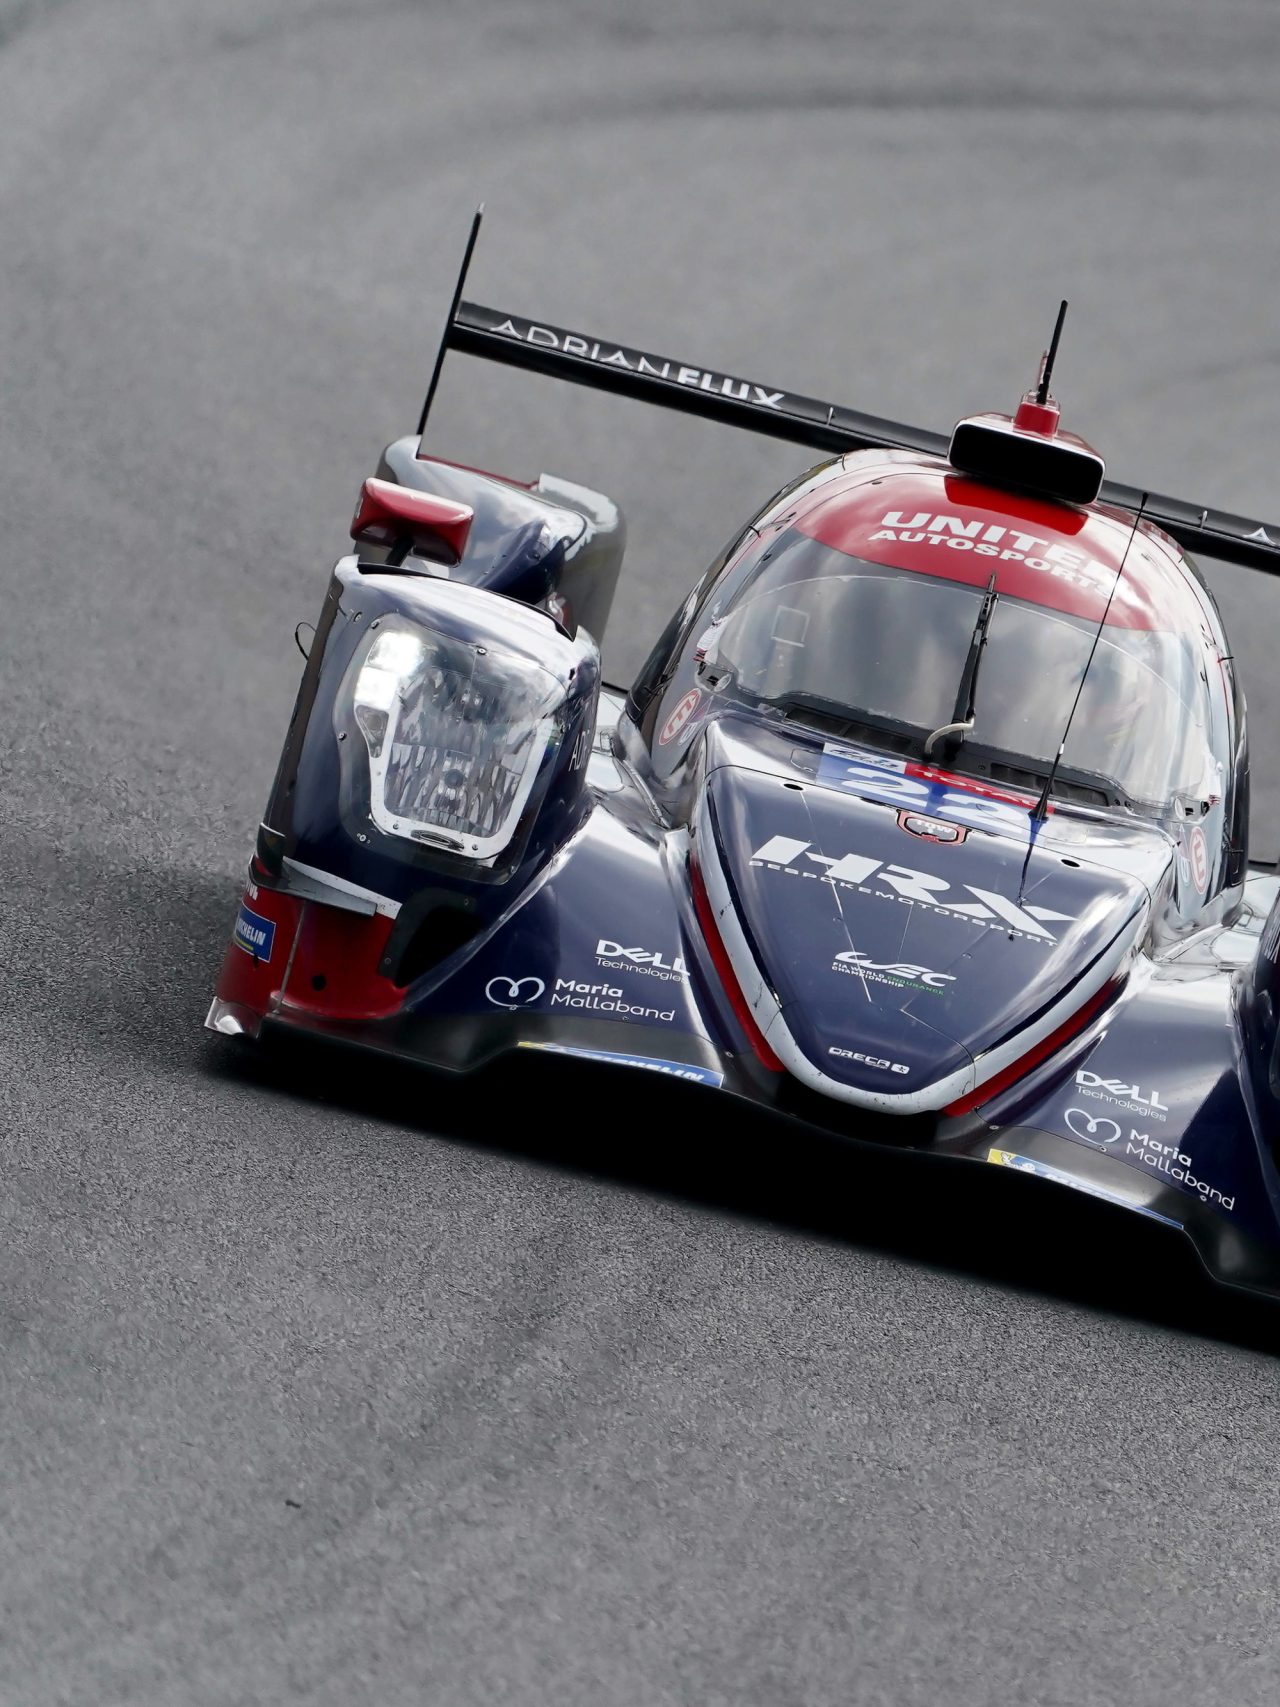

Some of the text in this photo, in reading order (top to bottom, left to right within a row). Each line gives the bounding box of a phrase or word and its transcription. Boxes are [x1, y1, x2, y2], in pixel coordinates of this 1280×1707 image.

[868, 529, 1117, 601] AUTOSPORTS
[842, 767, 1026, 835] 22
[595, 955, 690, 984] Technologies
[596, 939, 691, 976] DELL
[555, 978, 623, 998] Maria
[831, 965, 905, 988] CHAMPIONSHIP
[832, 961, 945, 996] FIA WORLD ENDURANCE
[550, 993, 676, 1022] Mallaband
[828, 1046, 891, 1069] ORECA
[1075, 1069, 1169, 1111] DELL
[1075, 1085, 1168, 1122] Technologies
[1129, 1128, 1193, 1167] Maria
[1126, 1143, 1236, 1211] Mallaband
